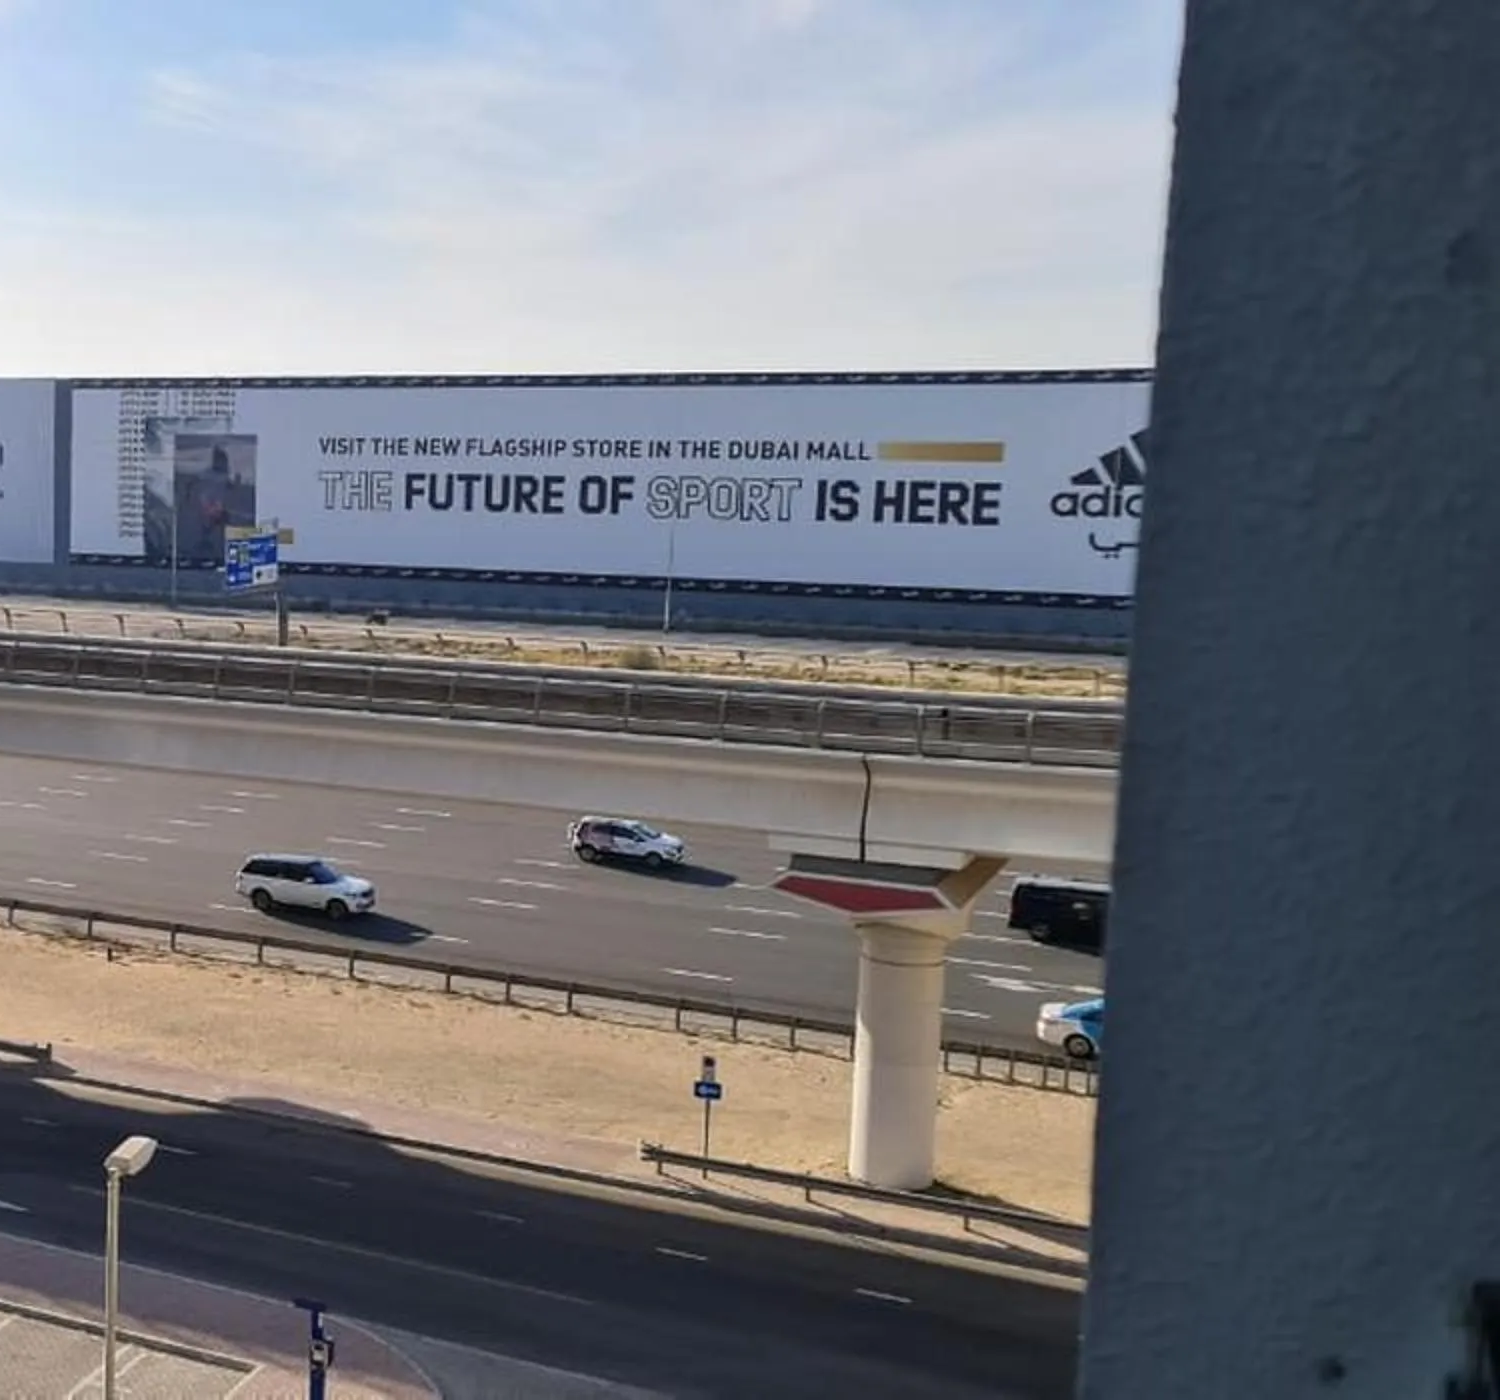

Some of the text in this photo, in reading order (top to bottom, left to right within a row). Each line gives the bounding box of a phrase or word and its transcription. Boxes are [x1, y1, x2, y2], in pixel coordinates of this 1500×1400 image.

[318, 437, 872, 462] VISIT THE NEW FLAGSHIP STORE IN THE DUBAI MALL
[318, 470, 1004, 526] THE FUTURE OF SPORT IS HERE
